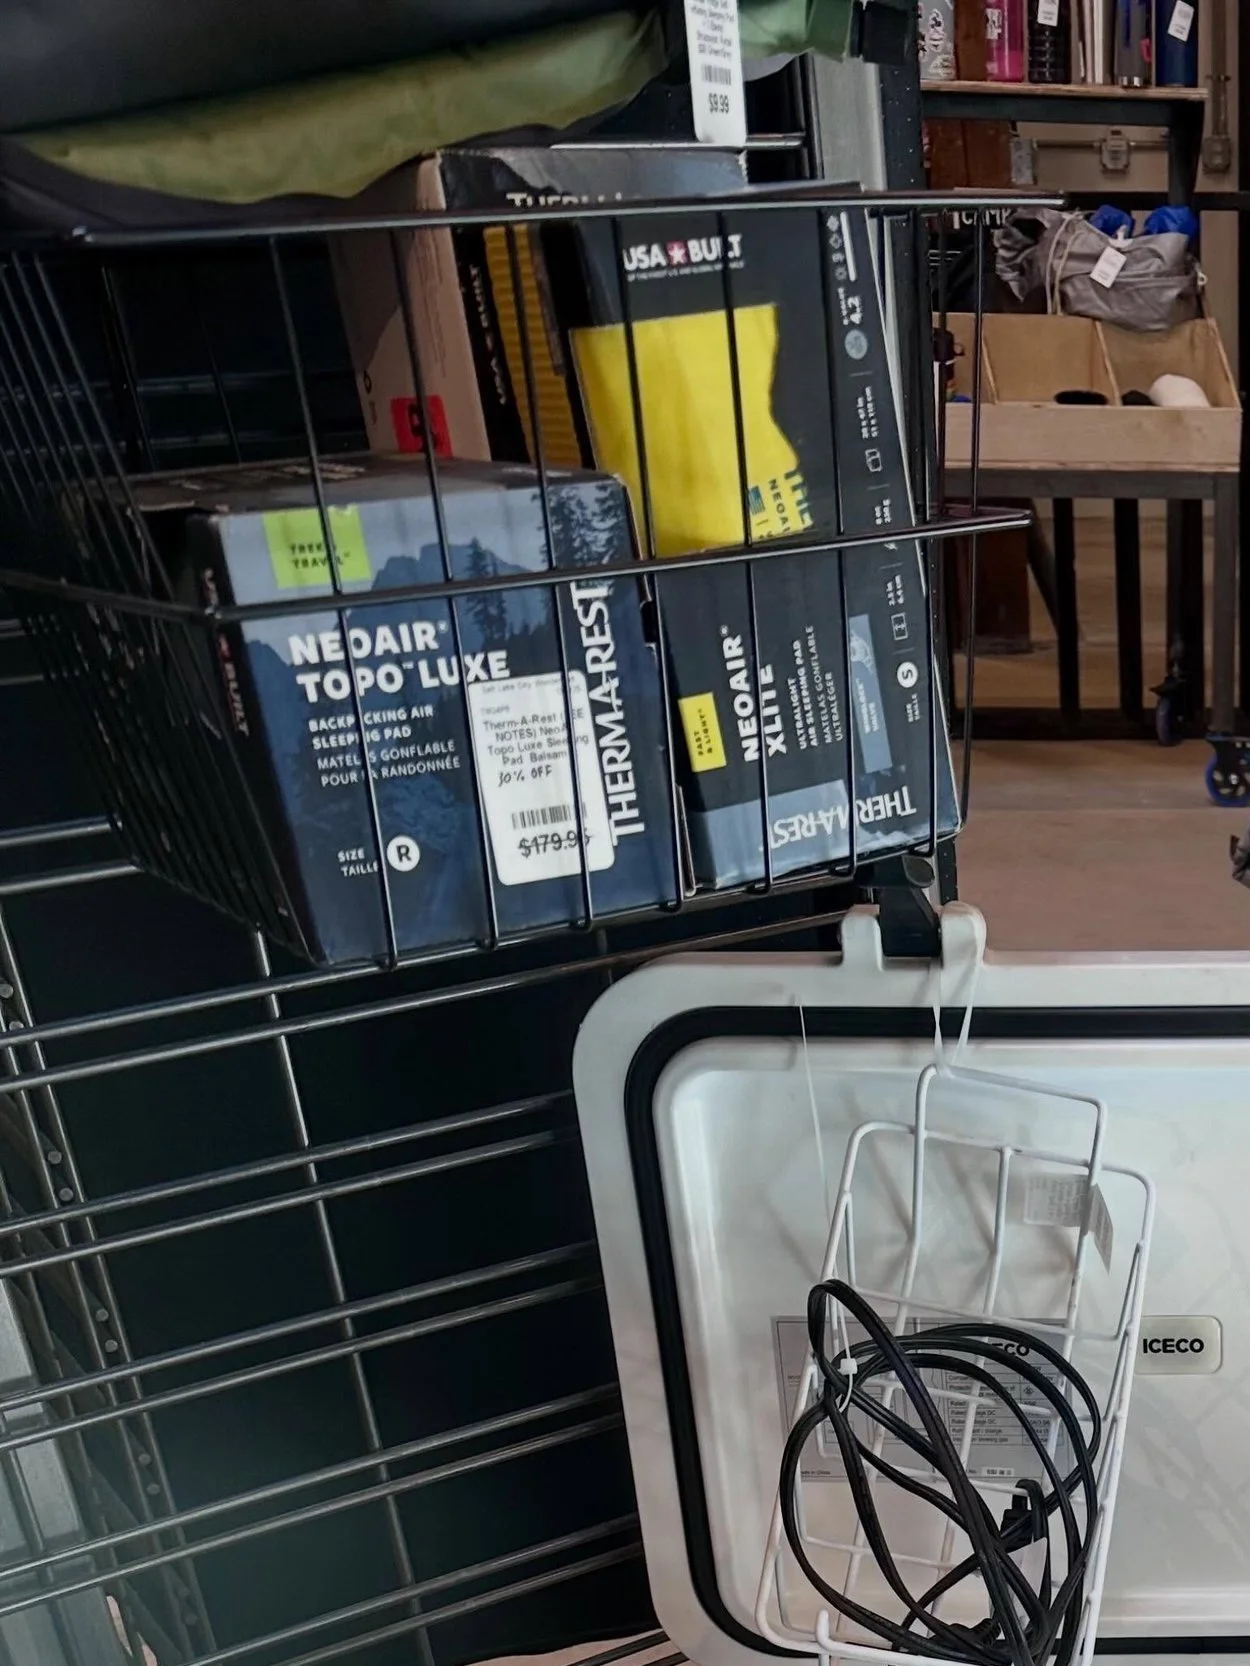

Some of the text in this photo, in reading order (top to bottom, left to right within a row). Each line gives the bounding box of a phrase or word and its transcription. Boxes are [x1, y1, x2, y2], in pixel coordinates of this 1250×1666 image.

[622, 233, 743, 271] USA BUIT
[418, 649, 510, 689] LUXE
[792, 639, 820, 747] AIR SLEEPING PAD
[805, 625, 833, 744] MATELAS GONFLABLE
[308, 704, 434, 733] BACKPCKING AIR
[760, 663, 788, 758] XLITE
[787, 677, 807, 750] ULTRALIGHT
[823, 671, 844, 741] ULTRALÉGER
[383, 724, 412, 740] PAD
[482, 711, 557, 730] Therm-A-Rest
[487, 743, 515, 757] Topo
[517, 740, 543, 753] Luxe
[495, 728, 538, 743] NOTES)
[694, 730, 705, 756] FAST
[317, 739, 456, 770] MATELS GONFLABLE
[501, 750, 567, 766] Pad Balsam
[321, 771, 358, 787] POUR
[381, 755, 461, 779] RANDONNÉE
[531, 764, 552, 779] OFF
[337, 847, 365, 862] SIZE
[396, 844, 412, 862] R
[1143, 1338, 1205, 1354] ICECO
